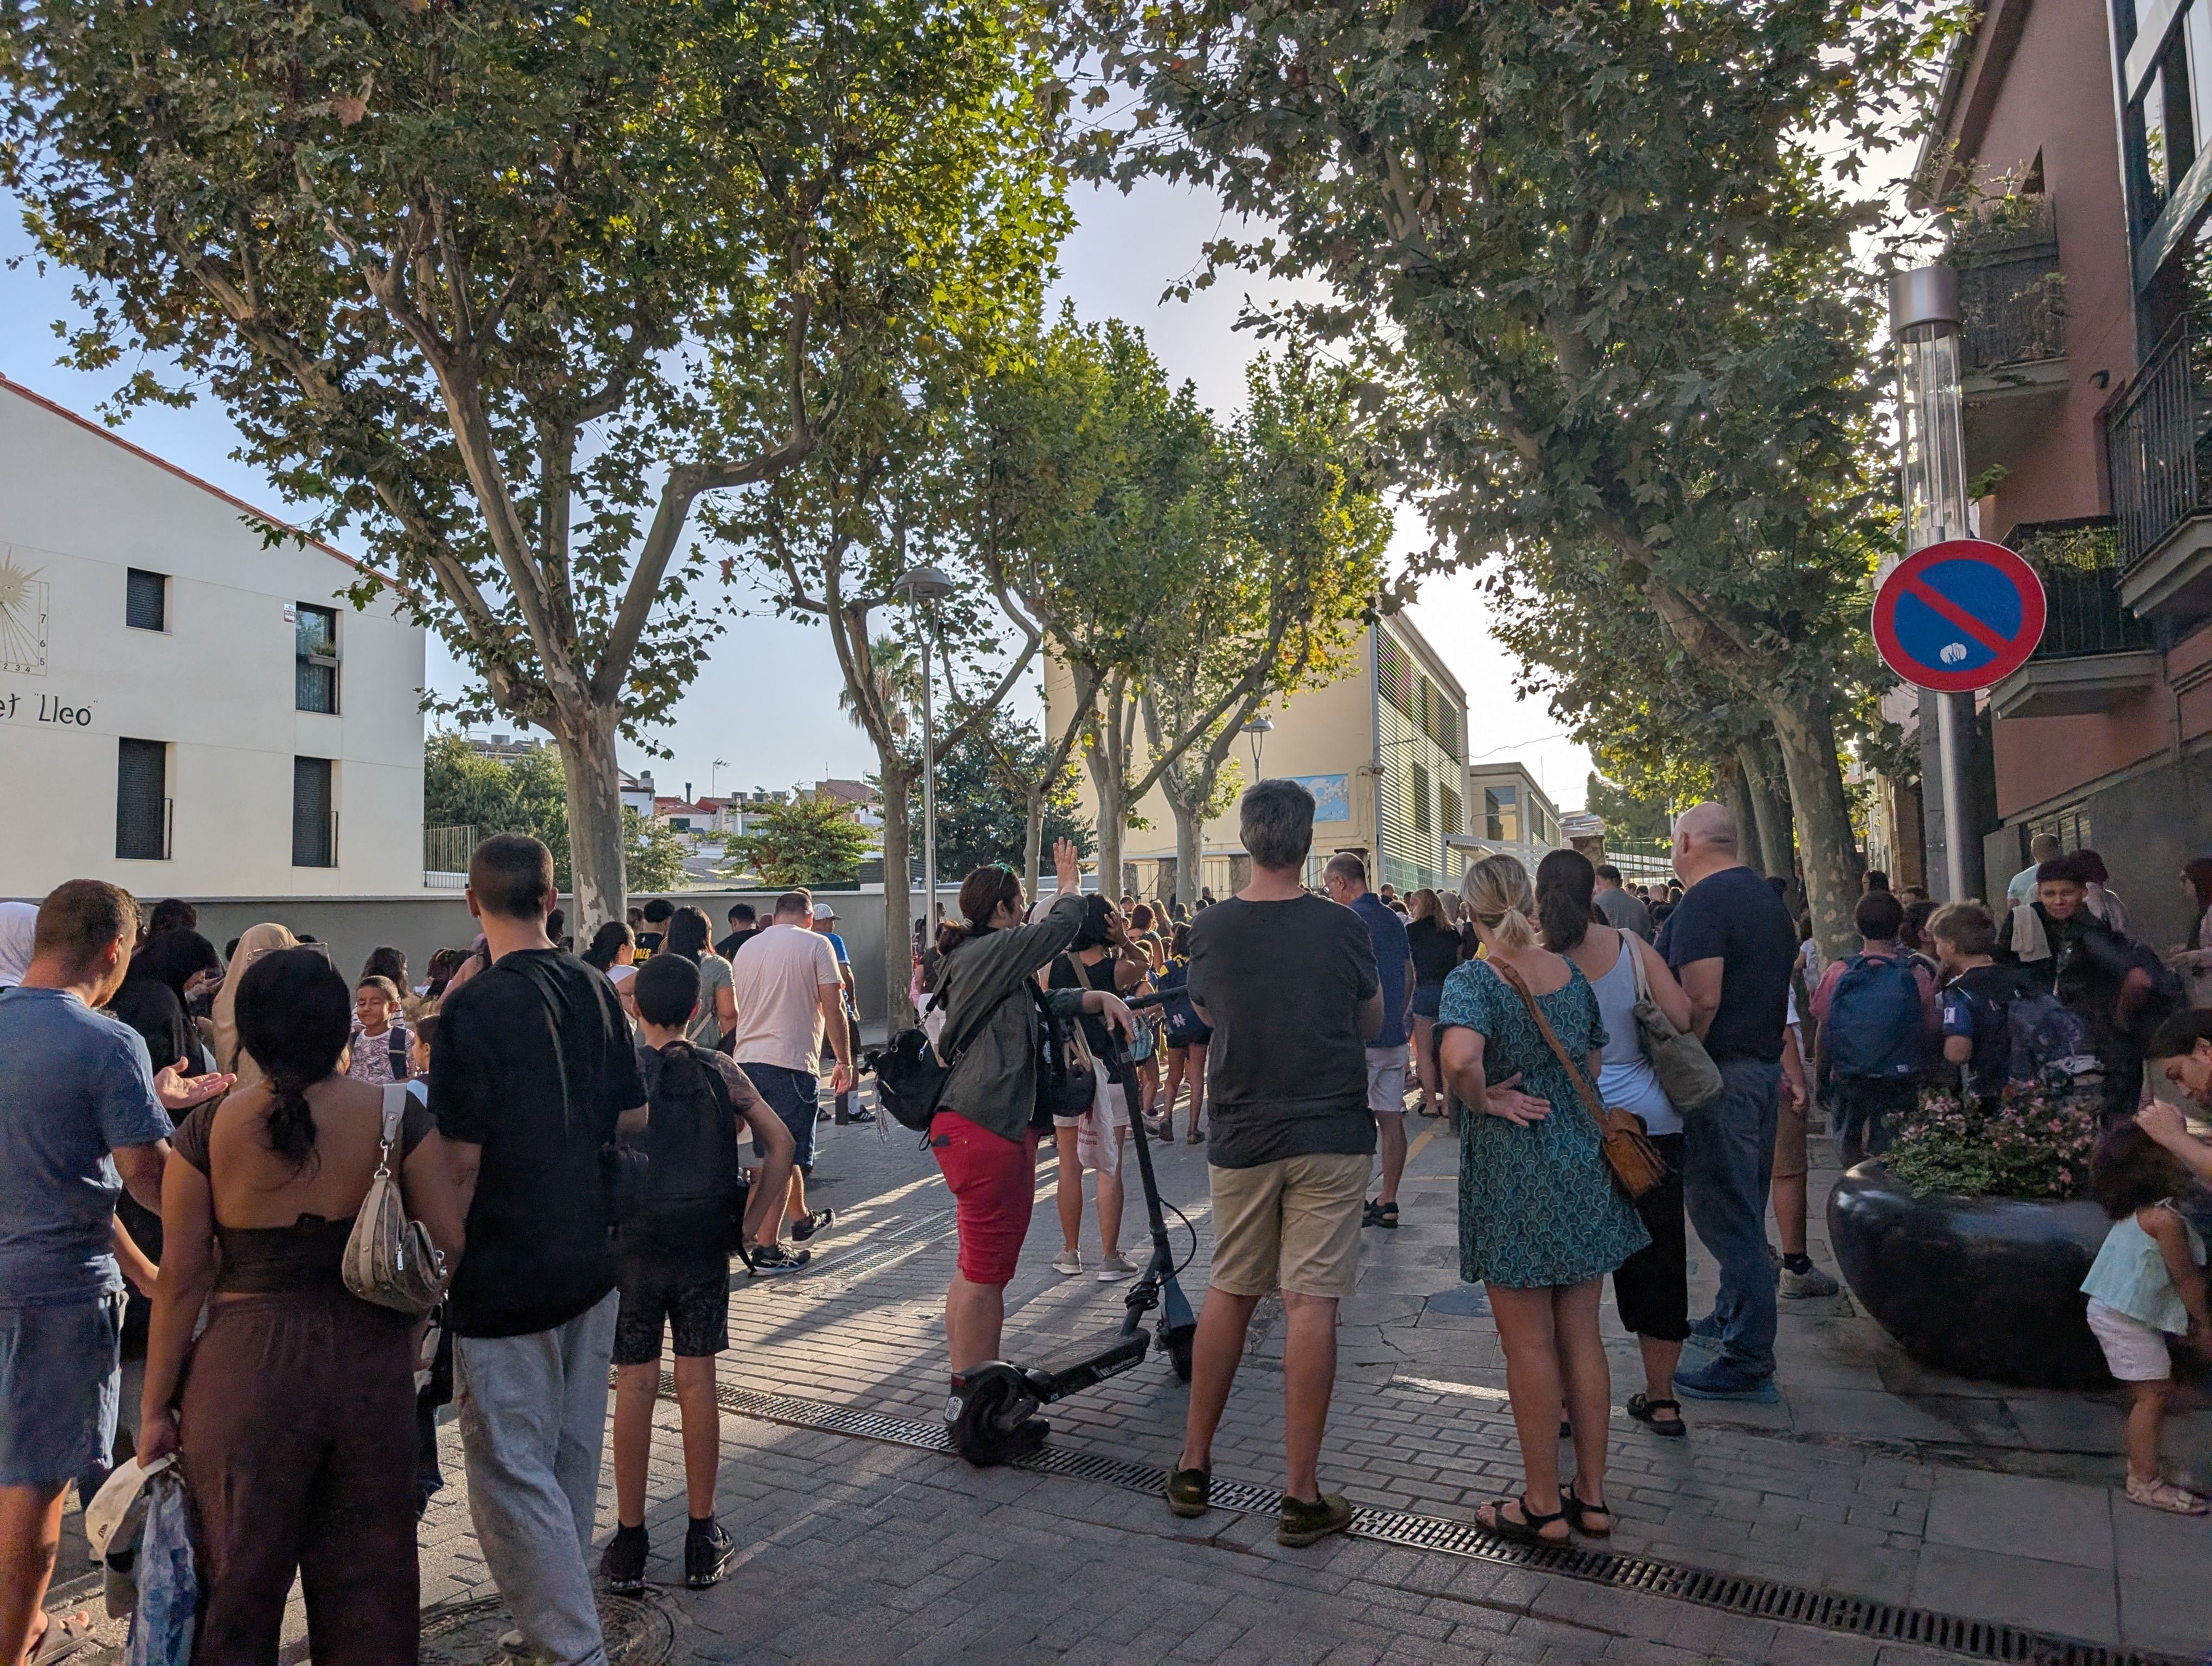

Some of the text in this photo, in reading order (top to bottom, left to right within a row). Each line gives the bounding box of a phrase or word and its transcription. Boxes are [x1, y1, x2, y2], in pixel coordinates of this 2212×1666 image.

[40, 614, 47, 624] 7
[40, 639, 46, 648] 6
[40, 658, 45, 666] 5
